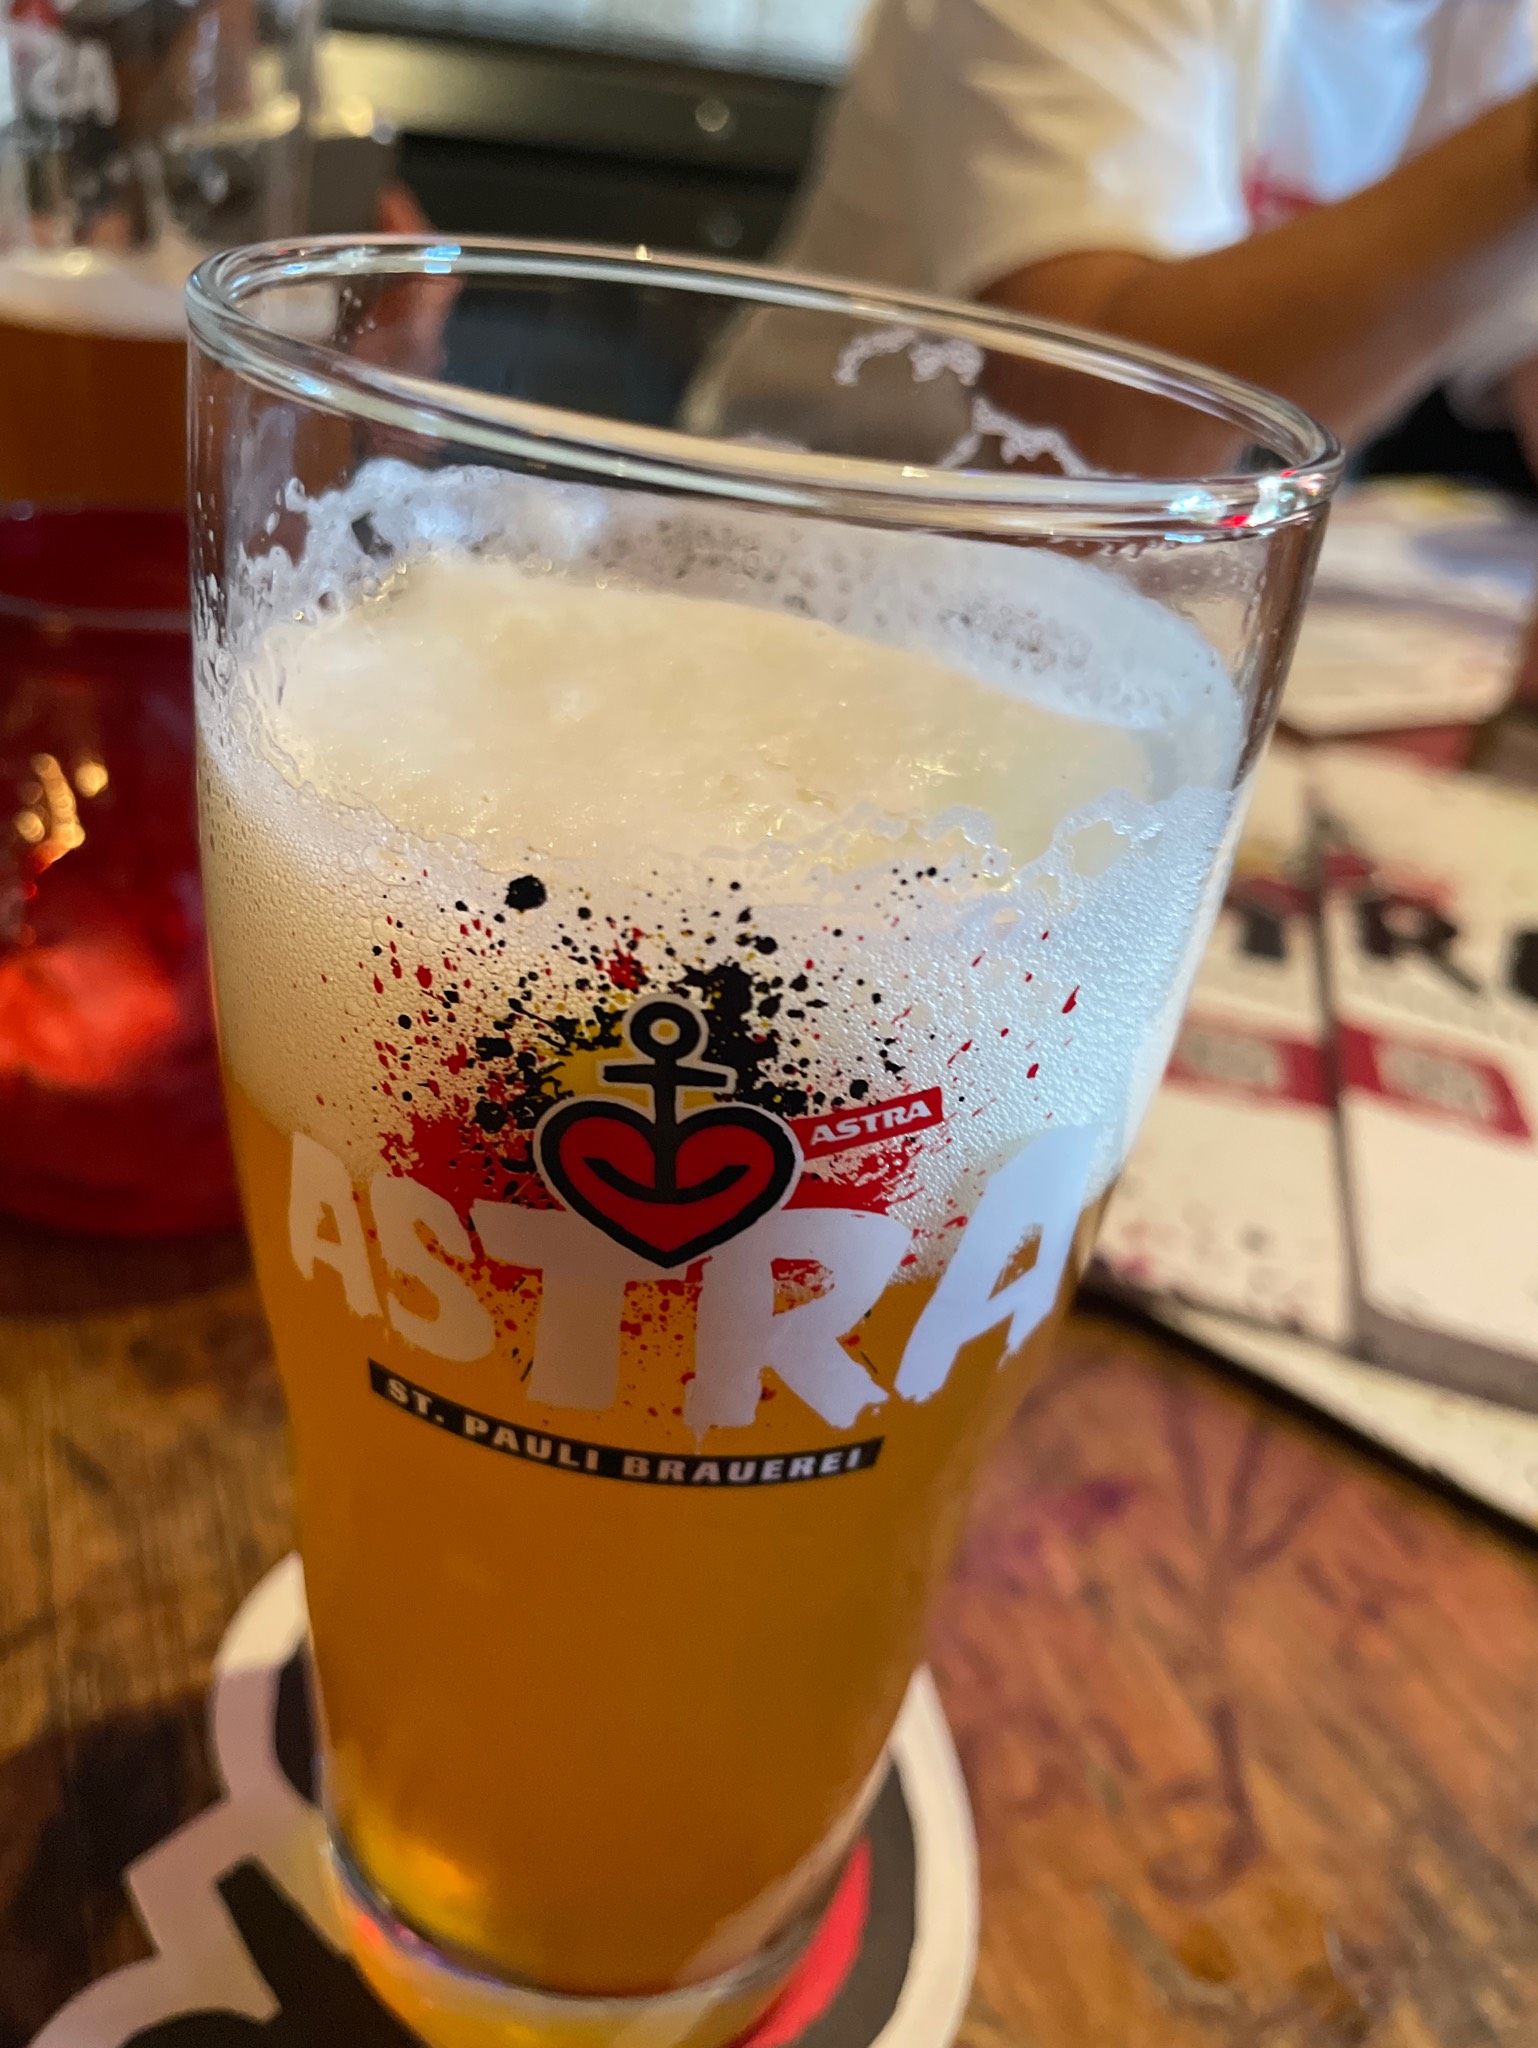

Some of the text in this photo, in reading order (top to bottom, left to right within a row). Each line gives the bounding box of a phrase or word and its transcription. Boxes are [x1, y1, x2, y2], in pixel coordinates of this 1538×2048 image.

[809, 1098, 932, 1147] ASTRA
[287, 1123, 1101, 1432] ASTRA
[384, 1377, 862, 1484] ST. PAULI BRAUEREI
